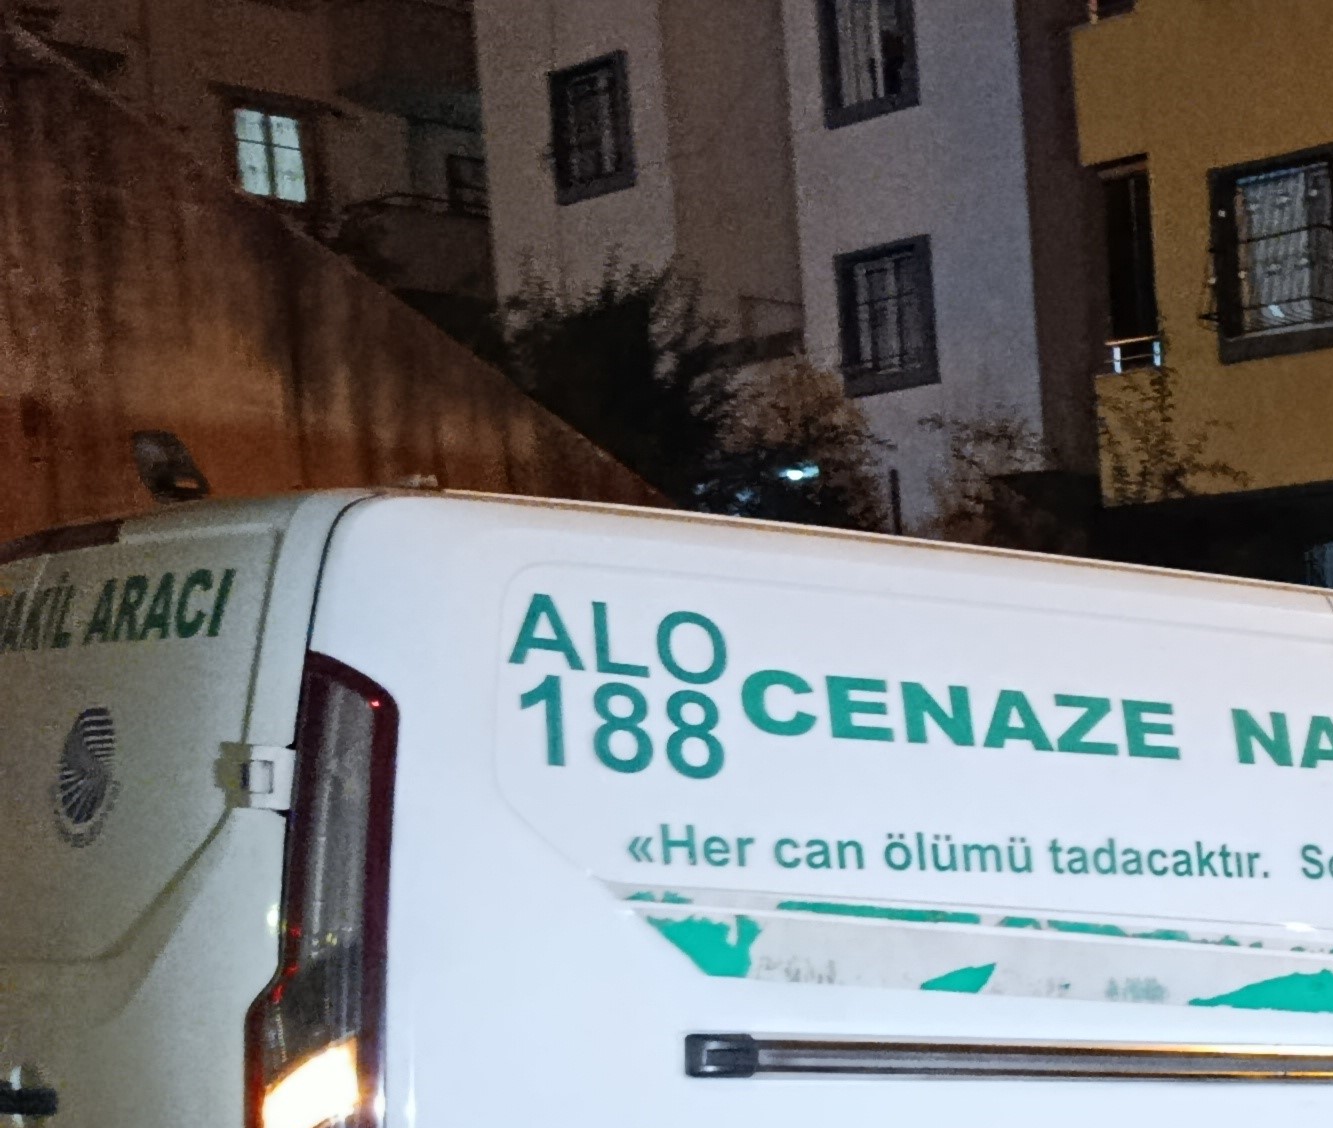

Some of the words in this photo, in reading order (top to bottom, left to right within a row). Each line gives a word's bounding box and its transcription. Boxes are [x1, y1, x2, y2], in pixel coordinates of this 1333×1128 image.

[83, 568, 237, 645] ARACI
[509, 593, 728, 685] ALO
[520, 674, 725, 780] 188
[740, 669, 1181, 760] CENAZE
[774, 836, 865, 870] can
[883, 832, 1032, 875] ölümü
[1049, 838, 1271, 880] tadacaktır.
